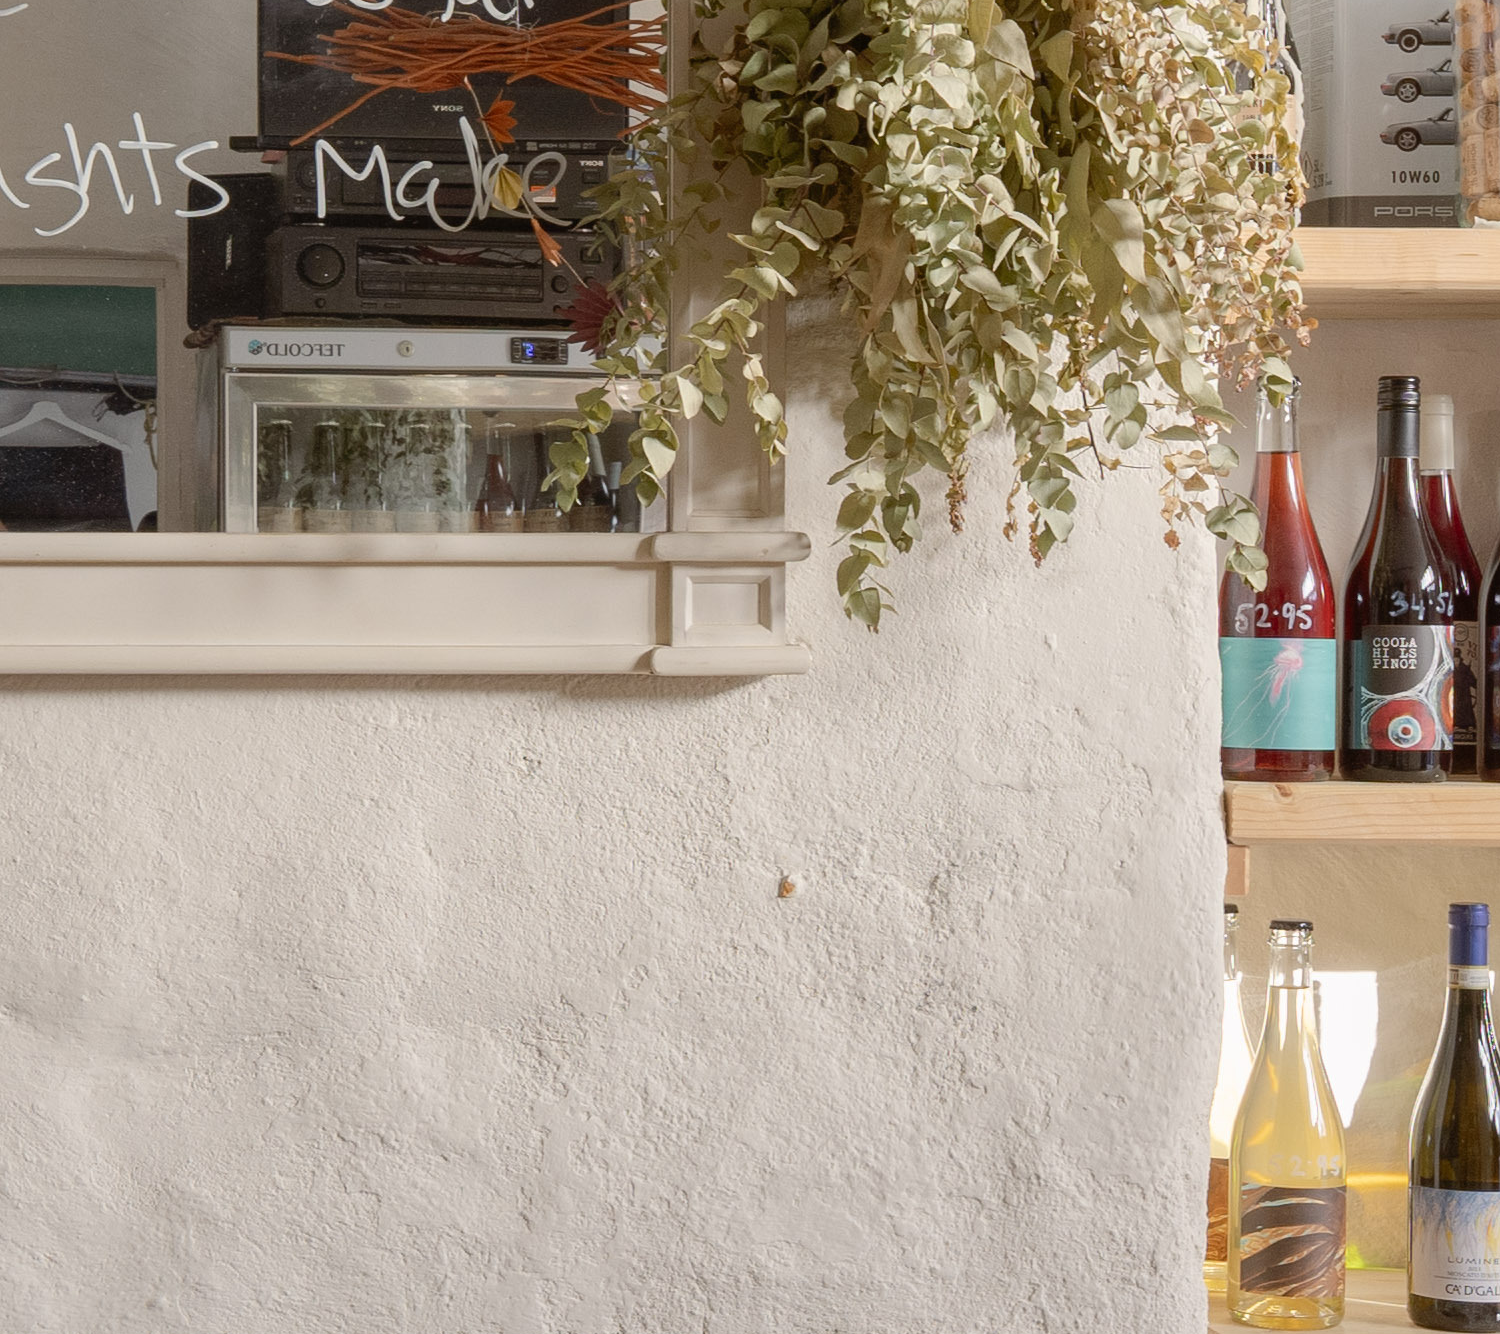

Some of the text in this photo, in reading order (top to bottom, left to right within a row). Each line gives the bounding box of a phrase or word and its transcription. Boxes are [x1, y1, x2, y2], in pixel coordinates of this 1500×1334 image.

[1391, 170, 1441, 184] 10W60
[1374, 206, 1454, 217] PORS
[1234, 603, 1314, 633] 52.95
[1373, 637, 1418, 648] COOLA
[1373, 658, 1418, 669] PINOT
[1447, 1256, 1500, 1265] LUMINE
